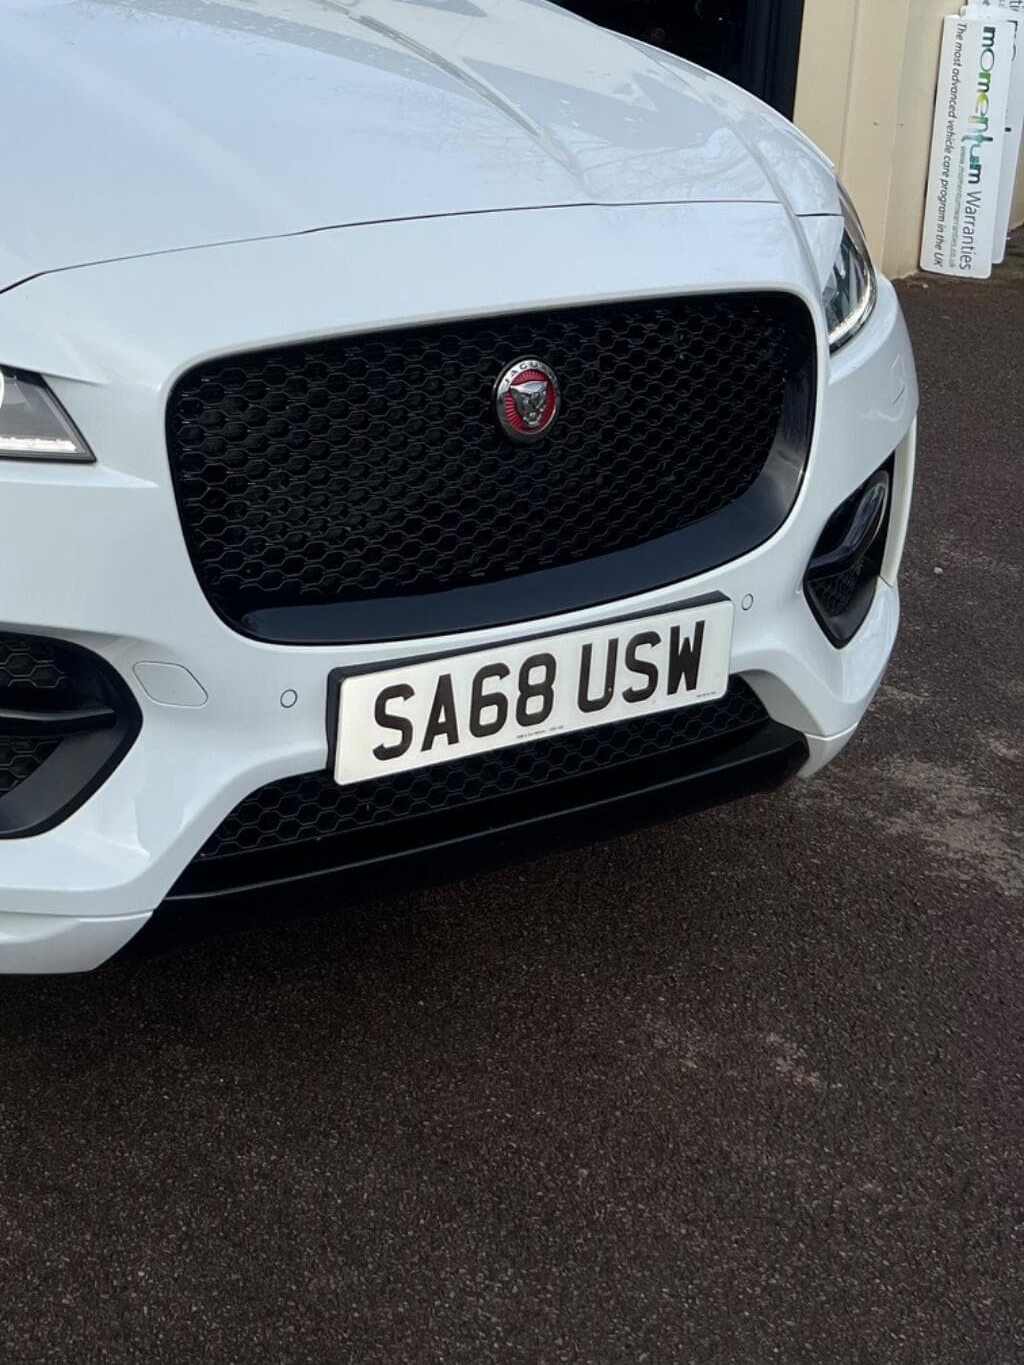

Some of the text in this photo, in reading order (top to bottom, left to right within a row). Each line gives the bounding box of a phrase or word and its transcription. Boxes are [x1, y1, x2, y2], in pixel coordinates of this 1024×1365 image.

[933, 22, 968, 268] The most advanced vehicle care program in the UK
[958, 26, 996, 271] momentum Warranties
[372, 620, 706, 761] SA68 USW
